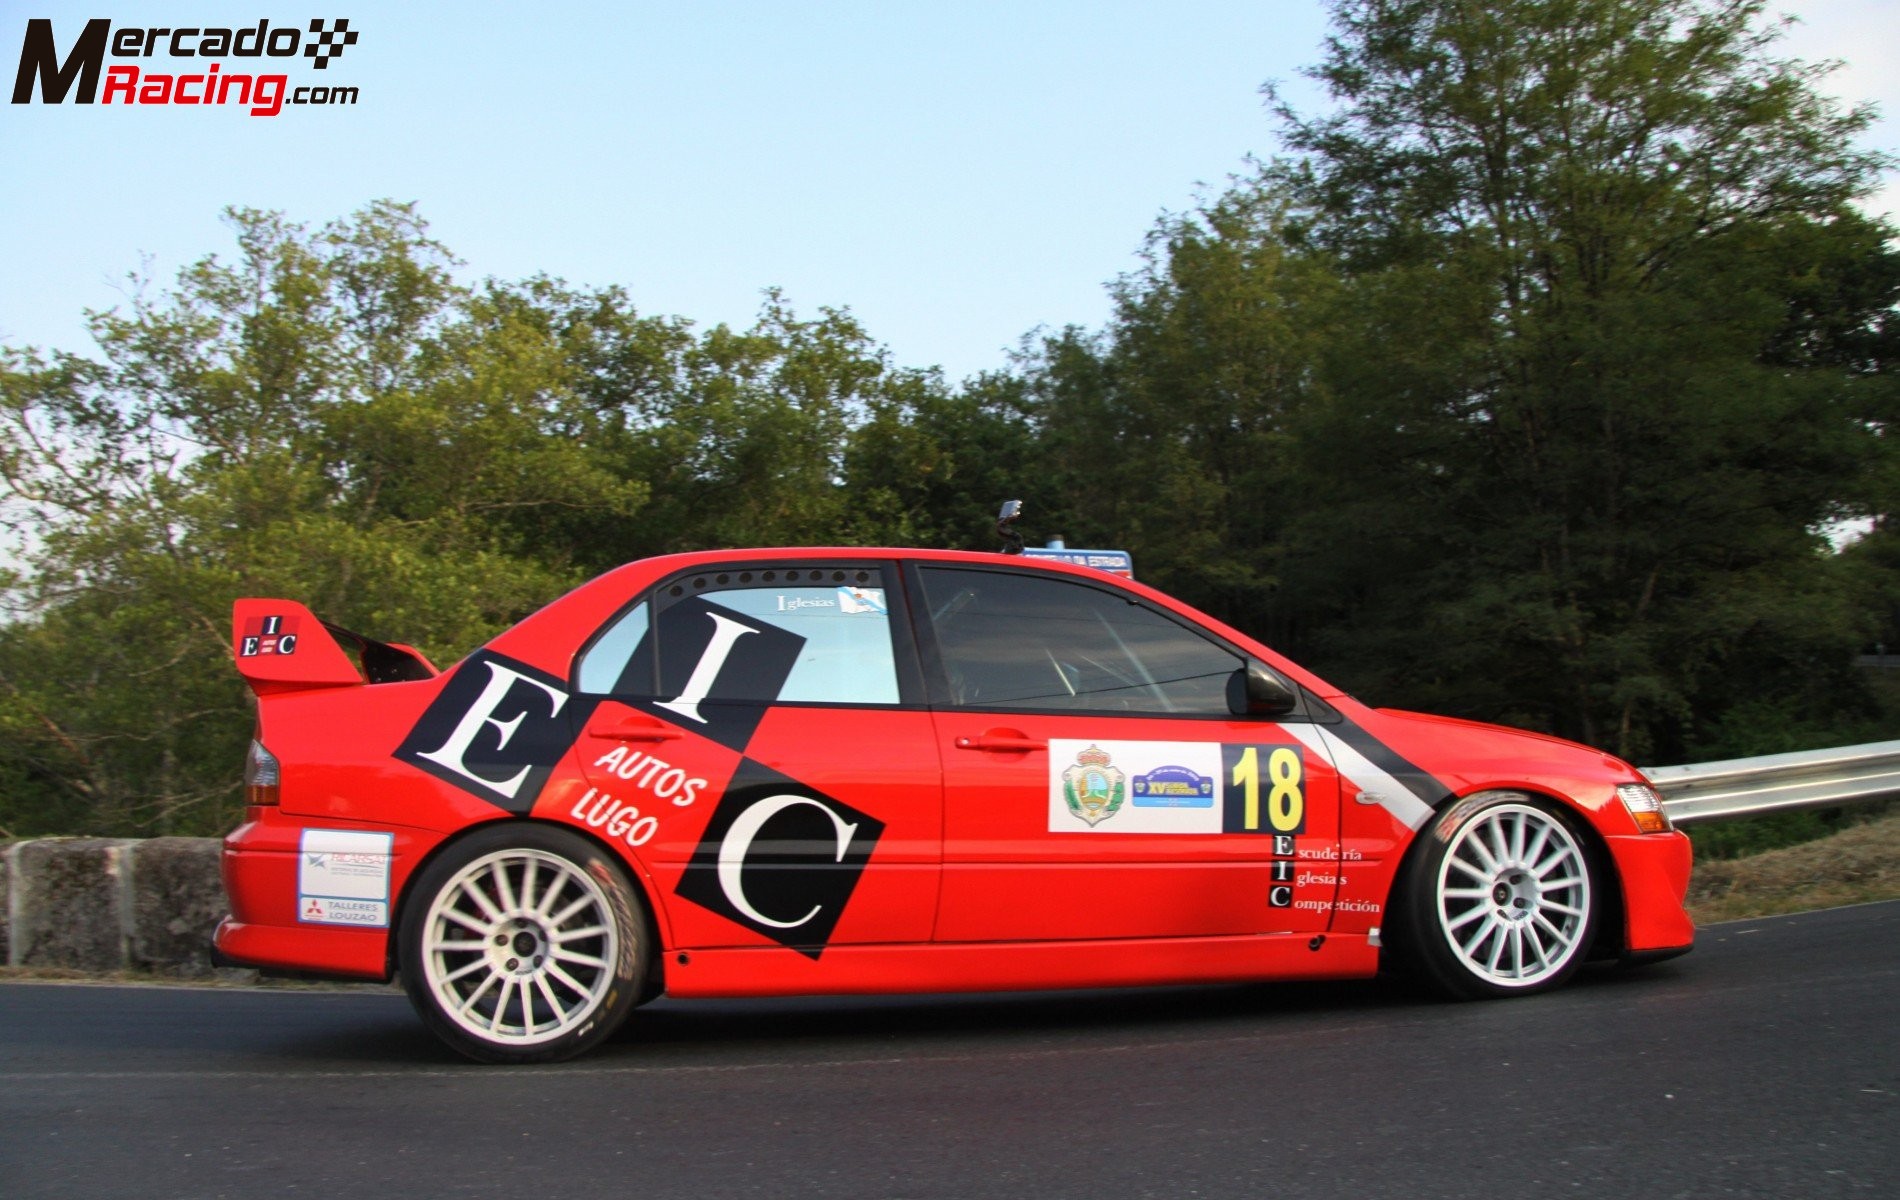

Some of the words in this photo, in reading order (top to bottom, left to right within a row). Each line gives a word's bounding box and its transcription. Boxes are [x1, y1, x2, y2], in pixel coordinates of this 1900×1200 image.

[777, 595, 835, 611] Iglesias
[594, 746, 708, 807] AUTOS
[1233, 747, 1303, 832] 18
[570, 787, 659, 847] LUGO
[328, 901, 378, 911] TALLERES
[329, 912, 377, 922] LOUZAO
